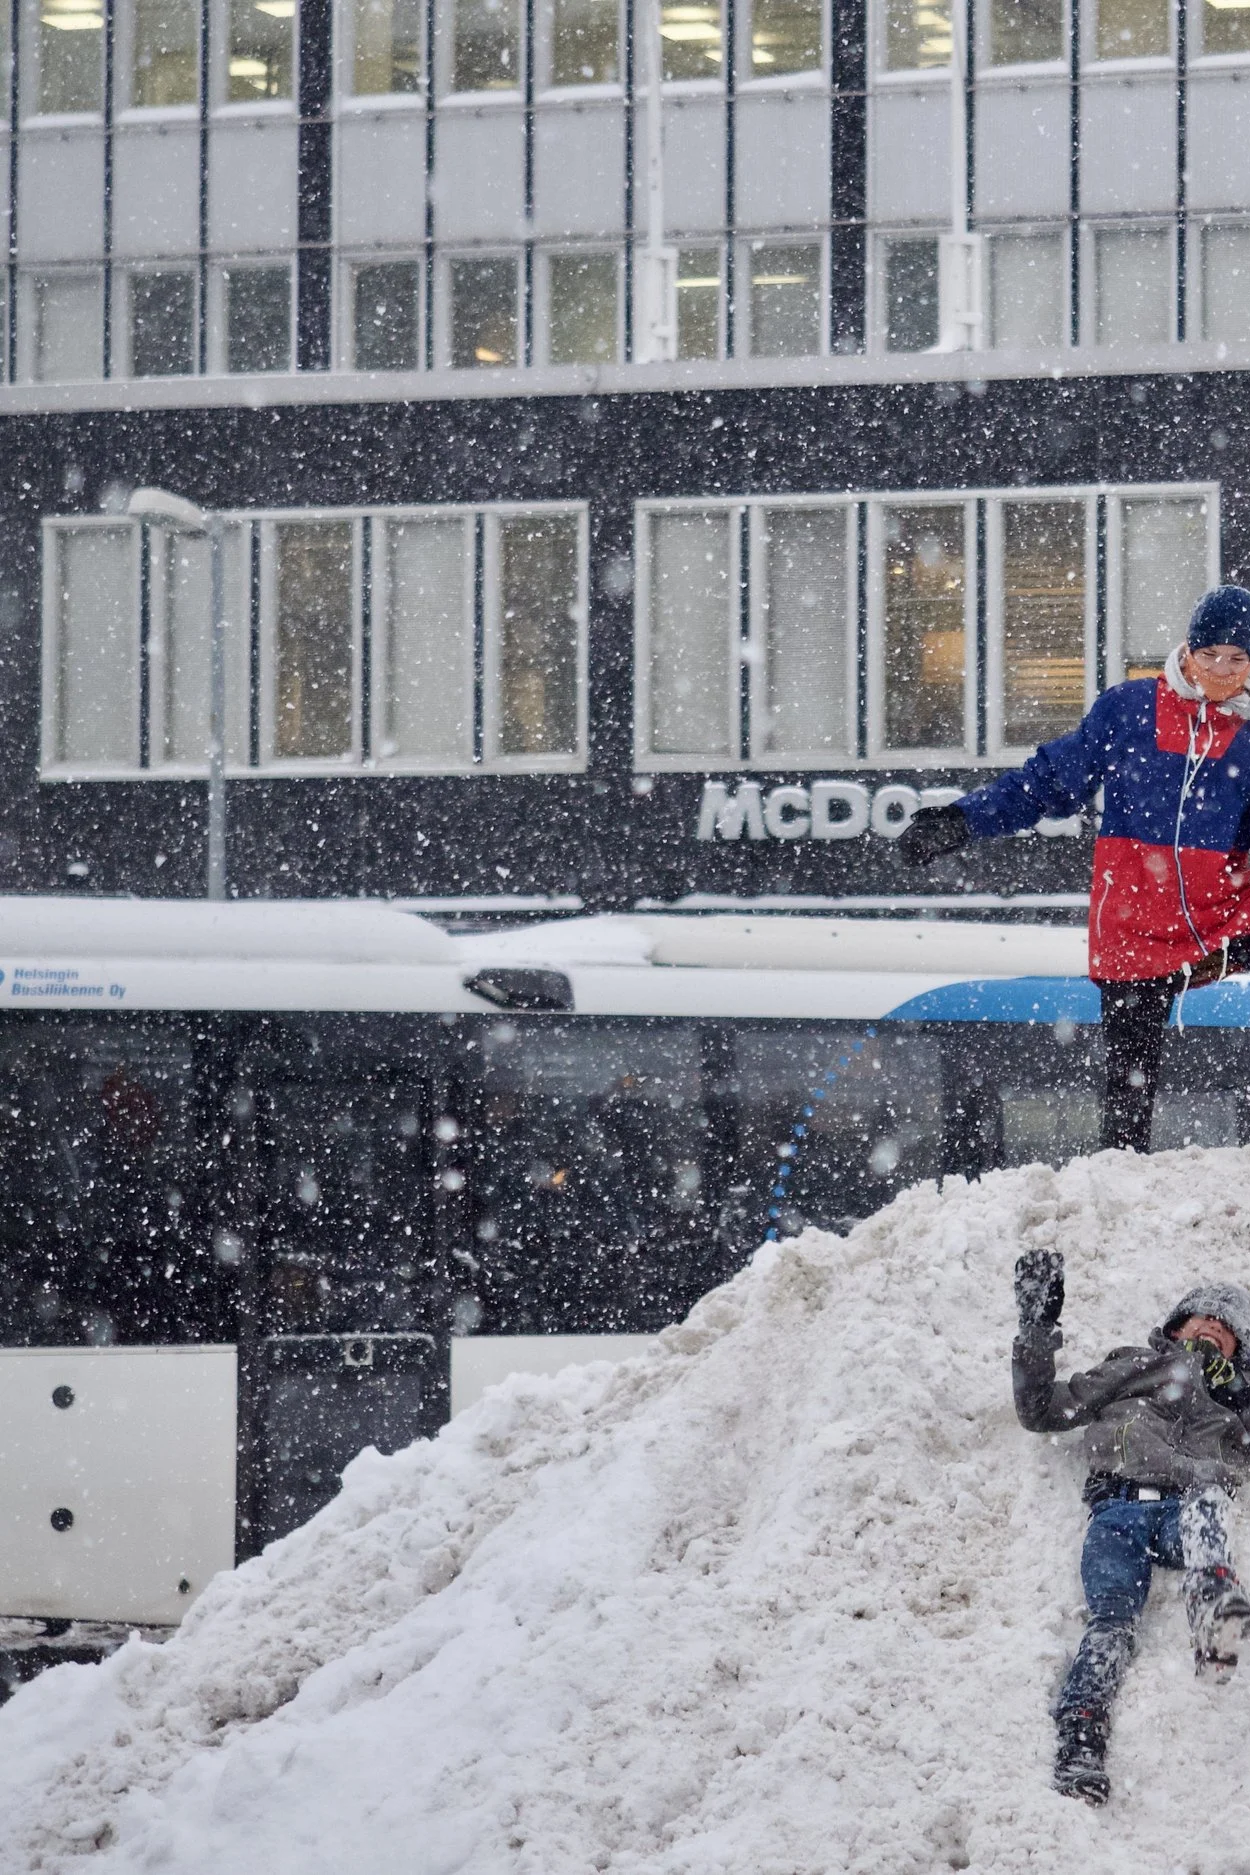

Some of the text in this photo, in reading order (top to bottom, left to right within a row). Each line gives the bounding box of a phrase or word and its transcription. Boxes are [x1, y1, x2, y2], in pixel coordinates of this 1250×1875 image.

[14, 968, 79, 982] Helsingin
[11, 983, 126, 999] Bussiliikenne Oy
